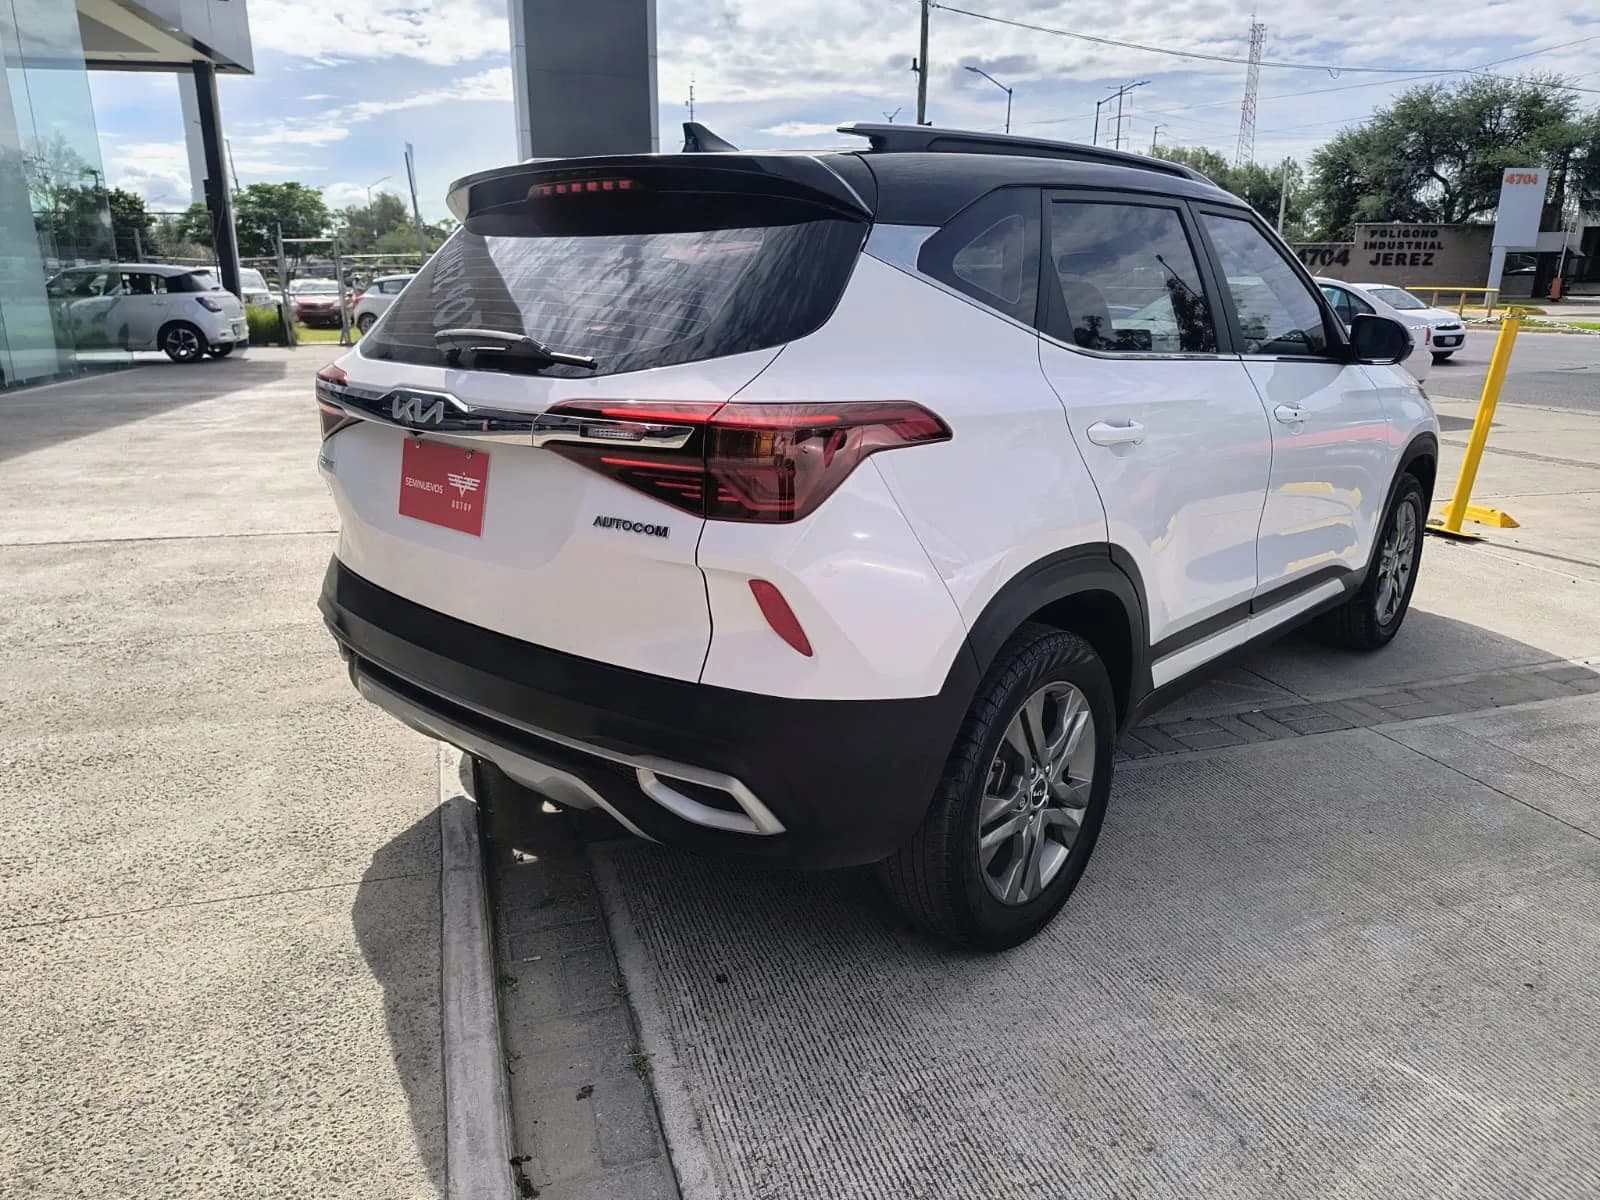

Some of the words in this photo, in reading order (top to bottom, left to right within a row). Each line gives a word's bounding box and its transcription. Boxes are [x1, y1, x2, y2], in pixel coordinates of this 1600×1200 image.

[1505, 173, 1538, 185] 4704
[1370, 229, 1438, 239] POLIGONO
[1364, 241, 1444, 251] INDUSTRIAL
[1369, 252, 1434, 267] JEREZ
[392, 395, 444, 425] KIA
[405, 476, 444, 494] SEMINUEVOS
[593, 515, 671, 537] AUTOCOM
